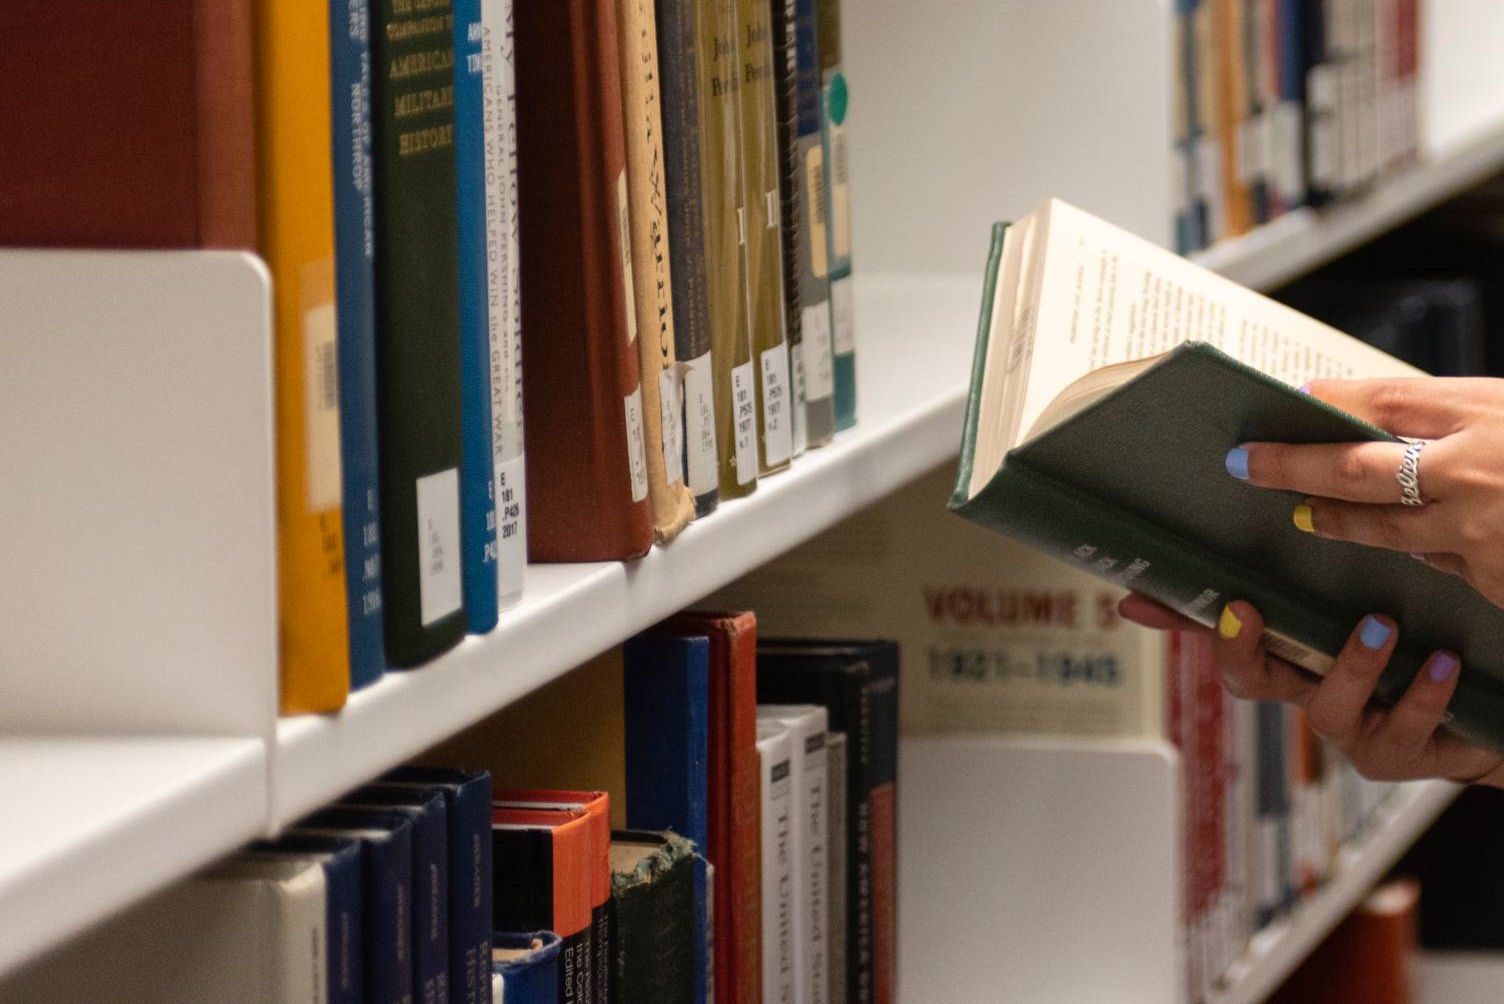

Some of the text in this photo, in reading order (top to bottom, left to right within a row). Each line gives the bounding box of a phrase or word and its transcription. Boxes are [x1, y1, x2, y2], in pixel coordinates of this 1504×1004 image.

[712, 37, 735, 62] Joh
[746, 24, 767, 48] Joh
[360, 50, 370, 114] TALES
[465, 52, 483, 74] TIM
[350, 82, 363, 192] NORTHROP
[362, 119, 371, 145] OF
[398, 122, 453, 156] HISTORY
[496, 84, 506, 167] GENERAL
[500, 4, 514, 67] My
[507, 92, 520, 244] Fellow
[362, 154, 374, 259] AMERICAN
[498, 175, 508, 224] JOHN
[483, 26, 503, 455] AMERICANS WHO HELPED WIN the GREAT WAR
[500, 231, 510, 323] PERSHING
[500, 471, 507, 486] E
[501, 487, 513, 502] 181
[502, 520, 518, 539] 2017
[926, 586, 1076, 629] VOLUME
[776, 812, 791, 865] The
[809, 779, 826, 1004] The United Stat
[776, 876, 792, 974] United
[565, 947, 574, 997] Edited
[576, 942, 584, 968] the
